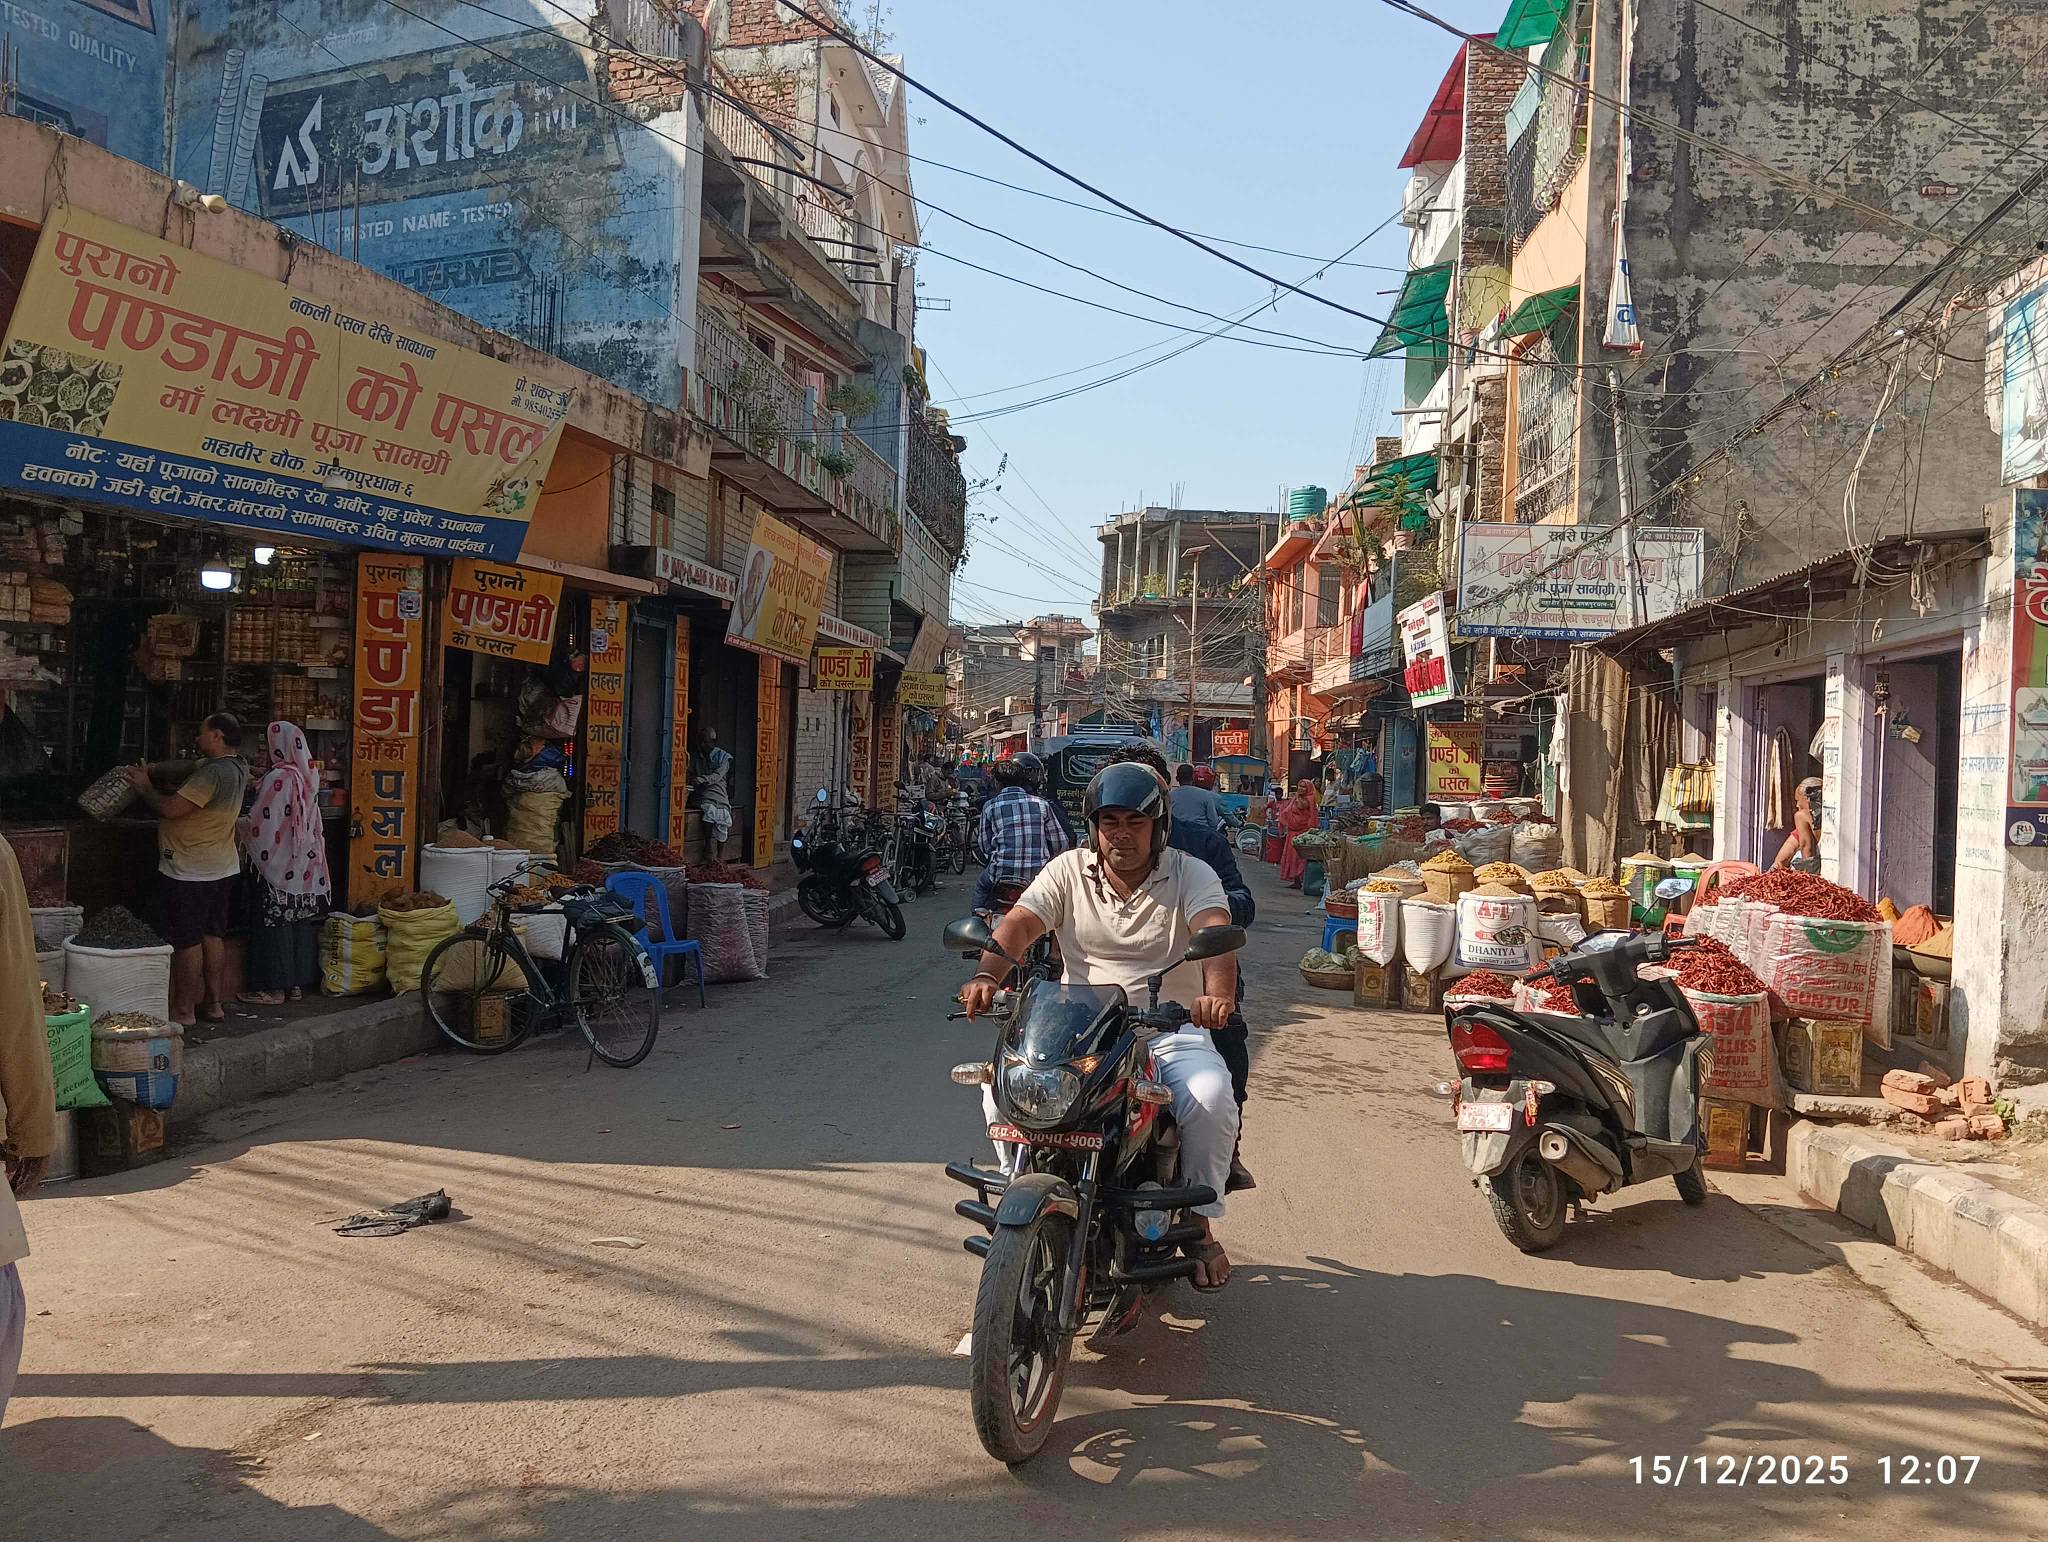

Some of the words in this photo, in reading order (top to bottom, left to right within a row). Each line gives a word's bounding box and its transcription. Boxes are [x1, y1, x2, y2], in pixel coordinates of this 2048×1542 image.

[68, 30, 137, 73] QUALITY
[54, 230, 182, 295] पुरानो
[289, 296, 332, 323] नकली
[334, 312, 366, 335] पसल
[395, 334, 438, 361] सावधान
[346, 361, 423, 432] को
[430, 392, 549, 465] पसल
[160, 385, 205, 416] माँ
[211, 398, 304, 439] लक्ष्मी
[310, 423, 368, 455] पूजा
[373, 439, 452, 476] सामग्री
[201, 436, 267, 464] महावीर
[21, 463, 100, 489] हवनको
[364, 522, 396, 542] उचित
[116, 452, 155, 473] यहाँ
[159, 460, 219, 486] पूजाको
[438, 517, 486, 535] उपनयन
[474, 569, 526, 592] पुरानो
[1619, 584, 1649, 596] पल
[475, 636, 518, 655] पसल
[819, 656, 852, 678] पण्डा
[854, 650, 872, 679] जी
[820, 678, 832, 687] को
[835, 680, 855, 688] पसल
[1438, 777, 1470, 791] पसल
[1468, 944, 1516, 957] DHANIYA
[1786, 988, 1860, 1013] GUNTUR
